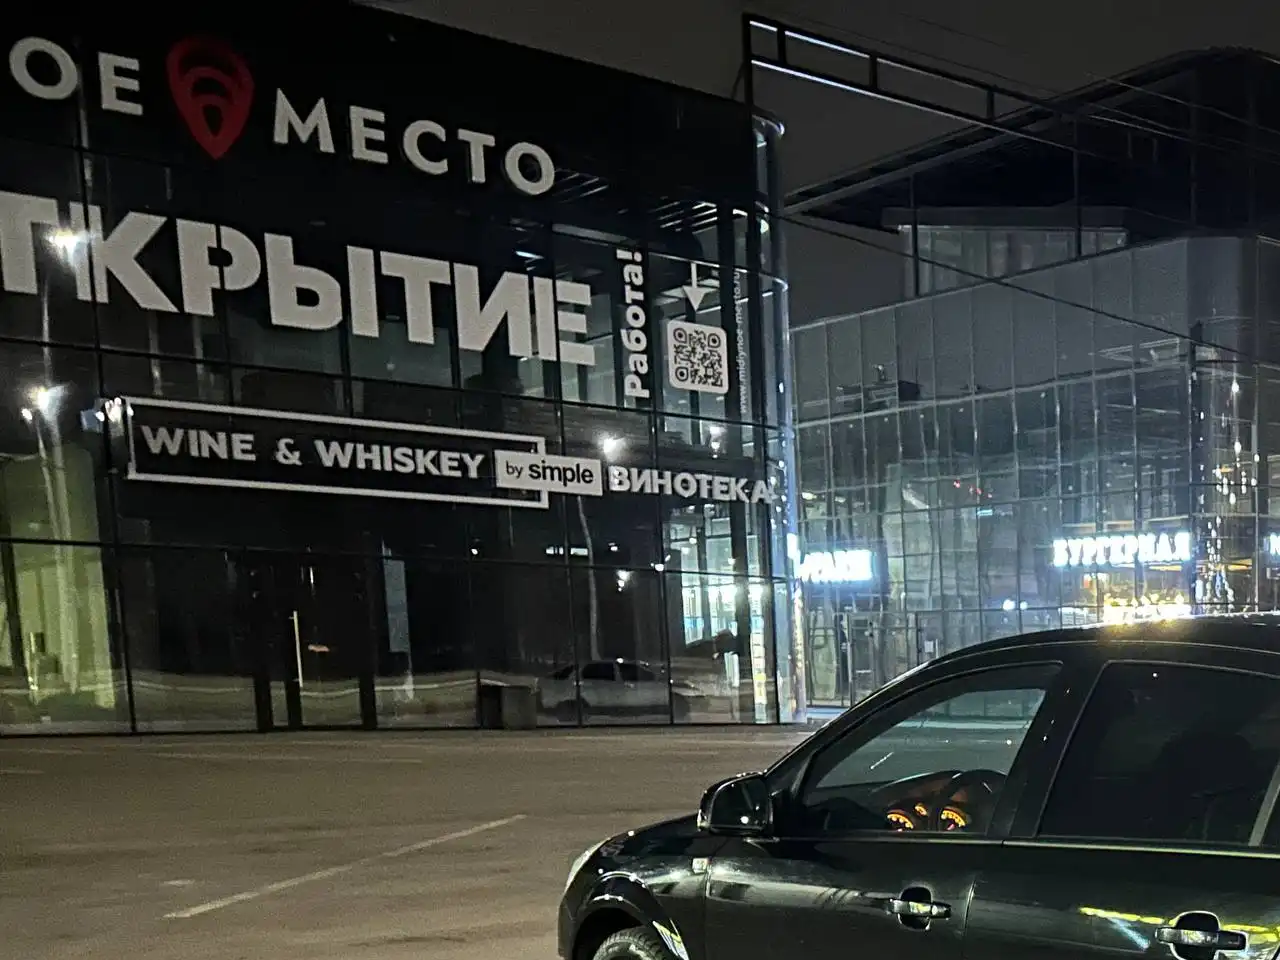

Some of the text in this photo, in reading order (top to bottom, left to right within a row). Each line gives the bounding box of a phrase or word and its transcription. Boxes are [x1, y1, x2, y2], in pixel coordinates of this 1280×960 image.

[273, 88, 555, 195] МЕСТО
[616, 248, 650, 399] Работа!
[140, 425, 485, 479] WINE & WHISKEY
[505, 459, 594, 488] by simple
[608, 466, 773, 505] ВИНОТЕКА
